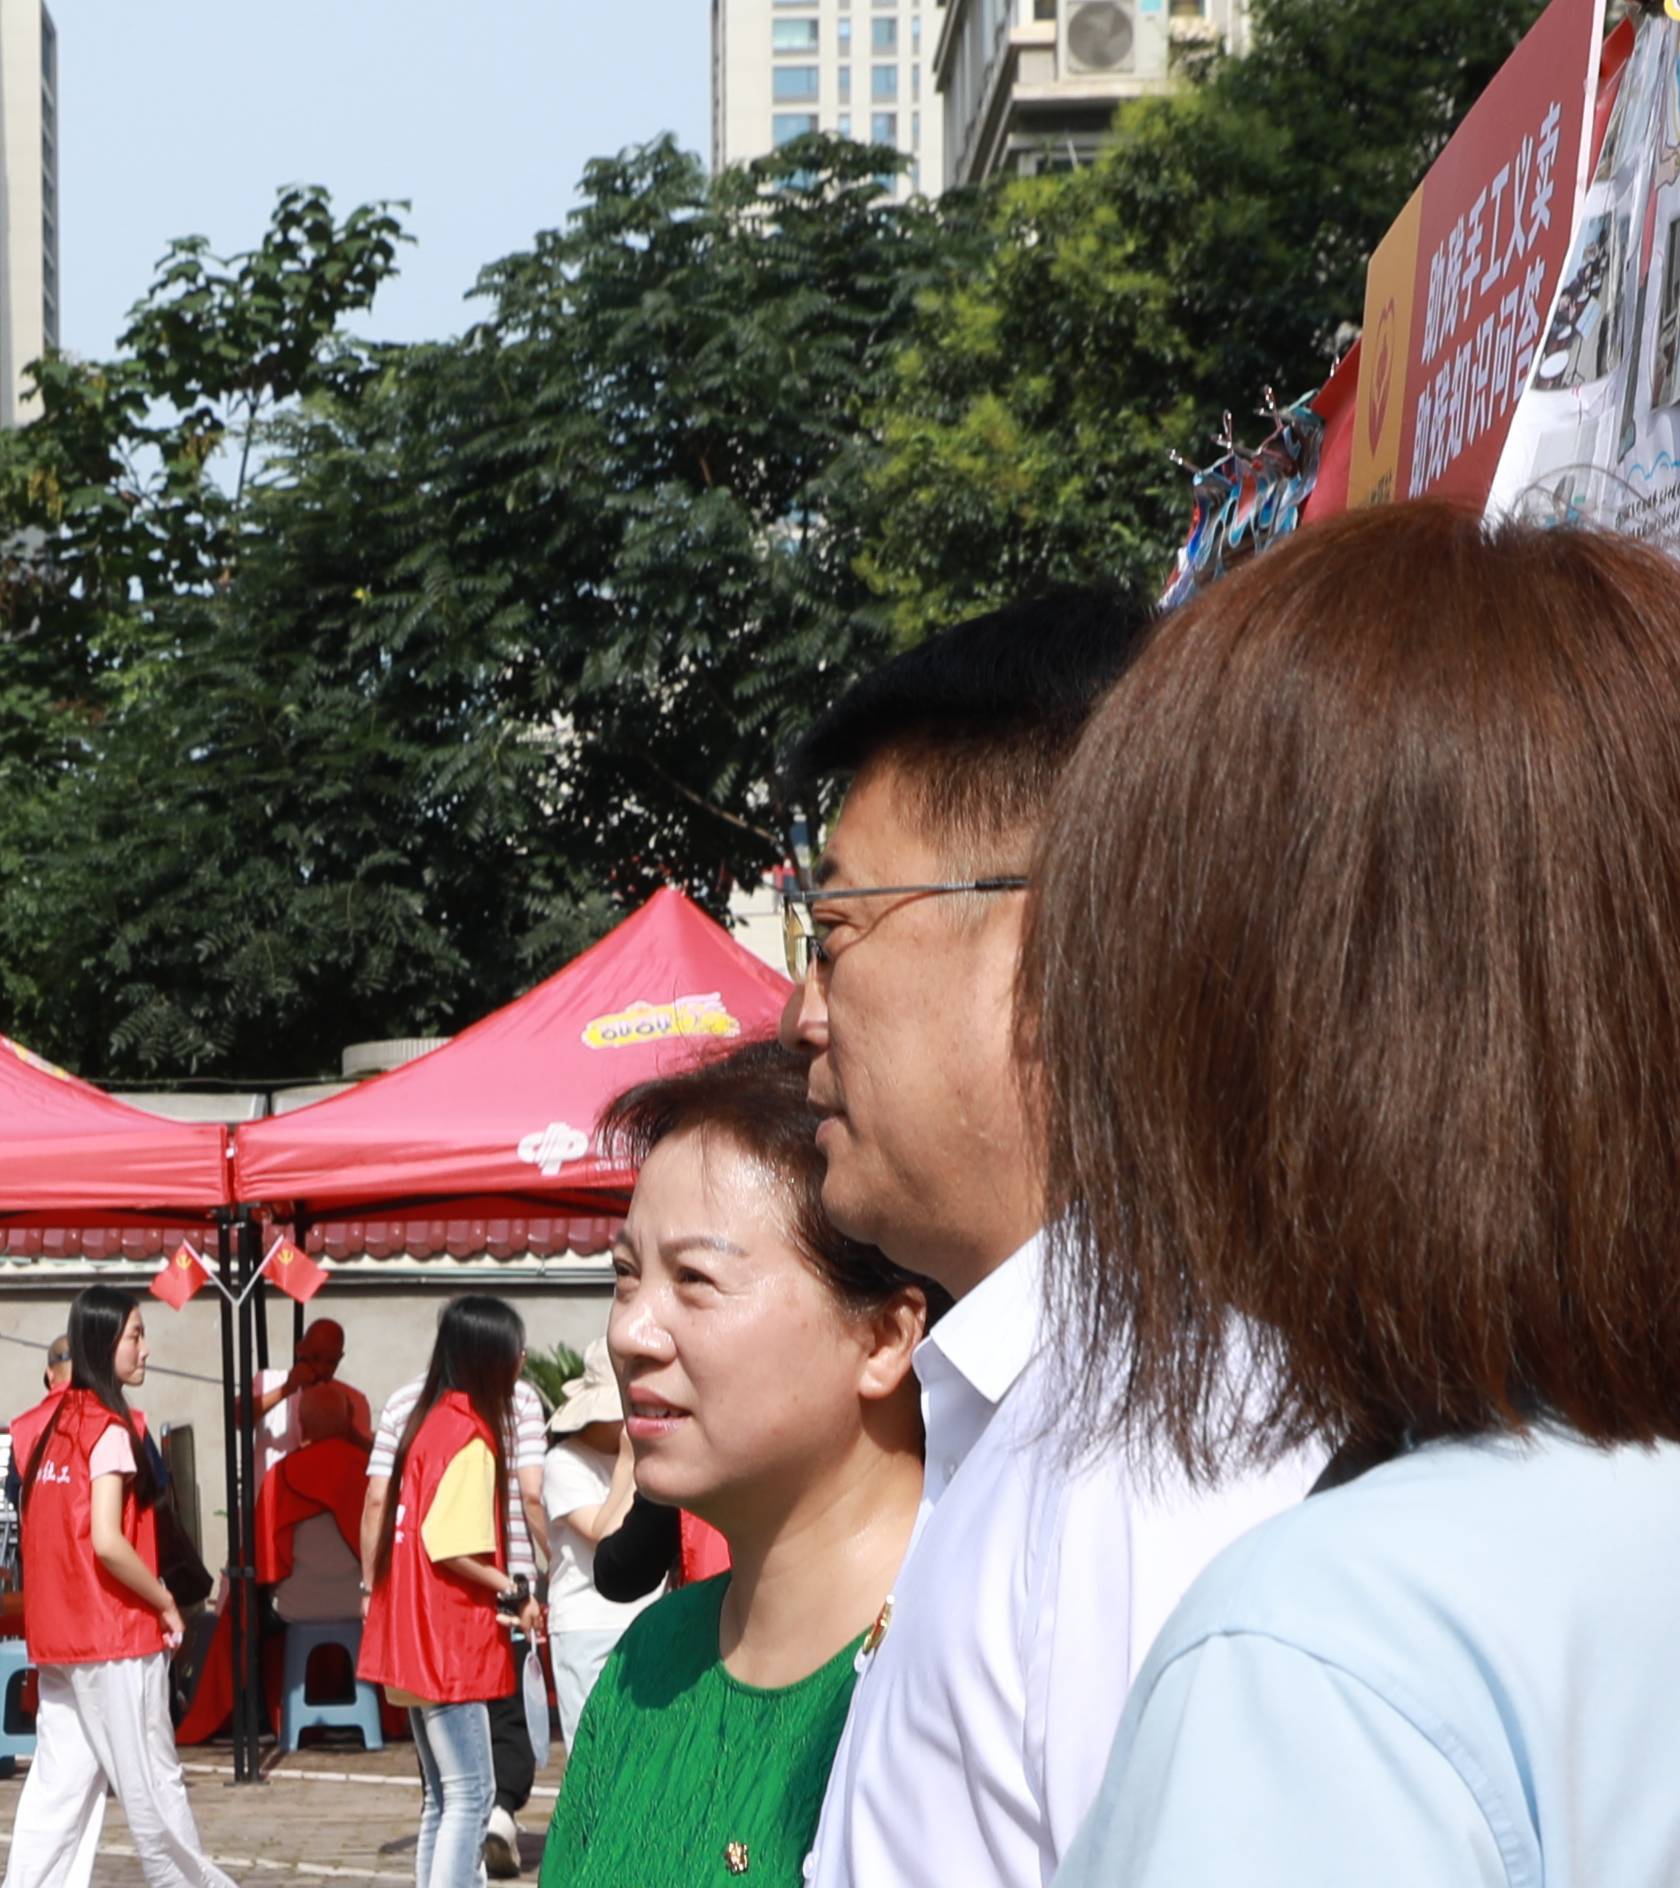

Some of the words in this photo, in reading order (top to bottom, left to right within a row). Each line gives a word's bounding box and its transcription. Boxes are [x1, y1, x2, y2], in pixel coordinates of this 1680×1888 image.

[1420, 101, 1562, 366] 助残手工义卖
[1409, 256, 1545, 500] 助残知识问答
